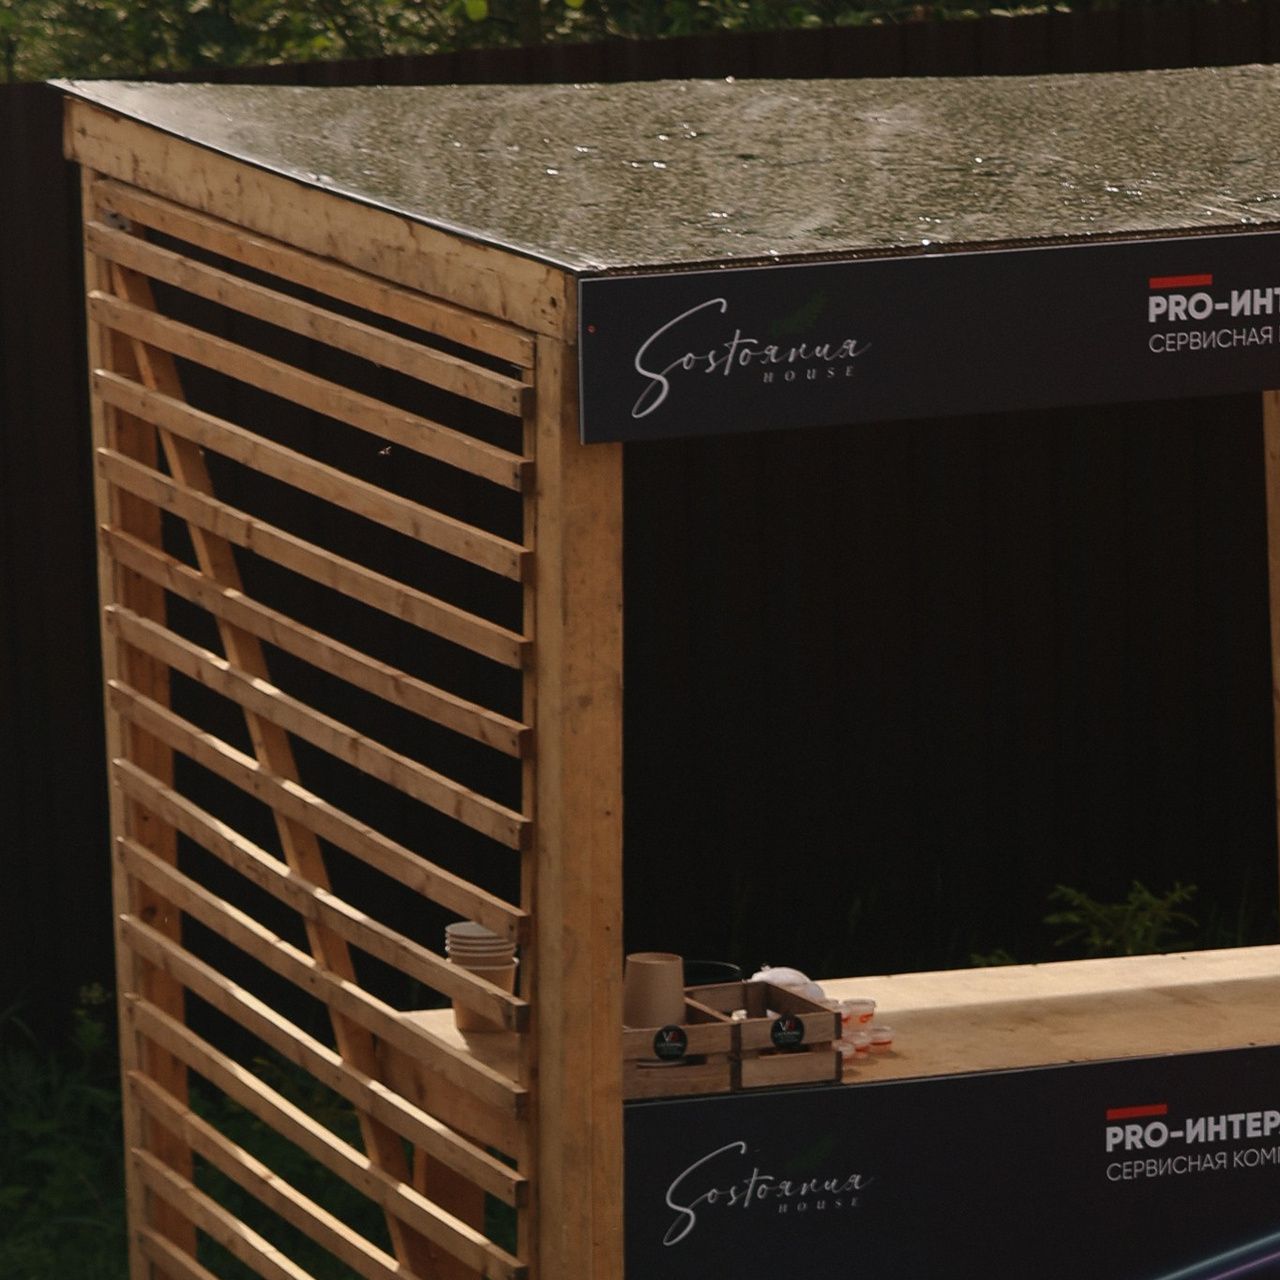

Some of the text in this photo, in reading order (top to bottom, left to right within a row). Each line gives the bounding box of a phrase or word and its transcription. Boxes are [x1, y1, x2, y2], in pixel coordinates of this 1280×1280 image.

[1148, 325, 1273, 353] СЕРВИСНАЯ
[762, 364, 855, 384] HOUSE
[1106, 1152, 1227, 1182] СЕРВИСНАЯ
[778, 1197, 859, 1214] HOUSE
